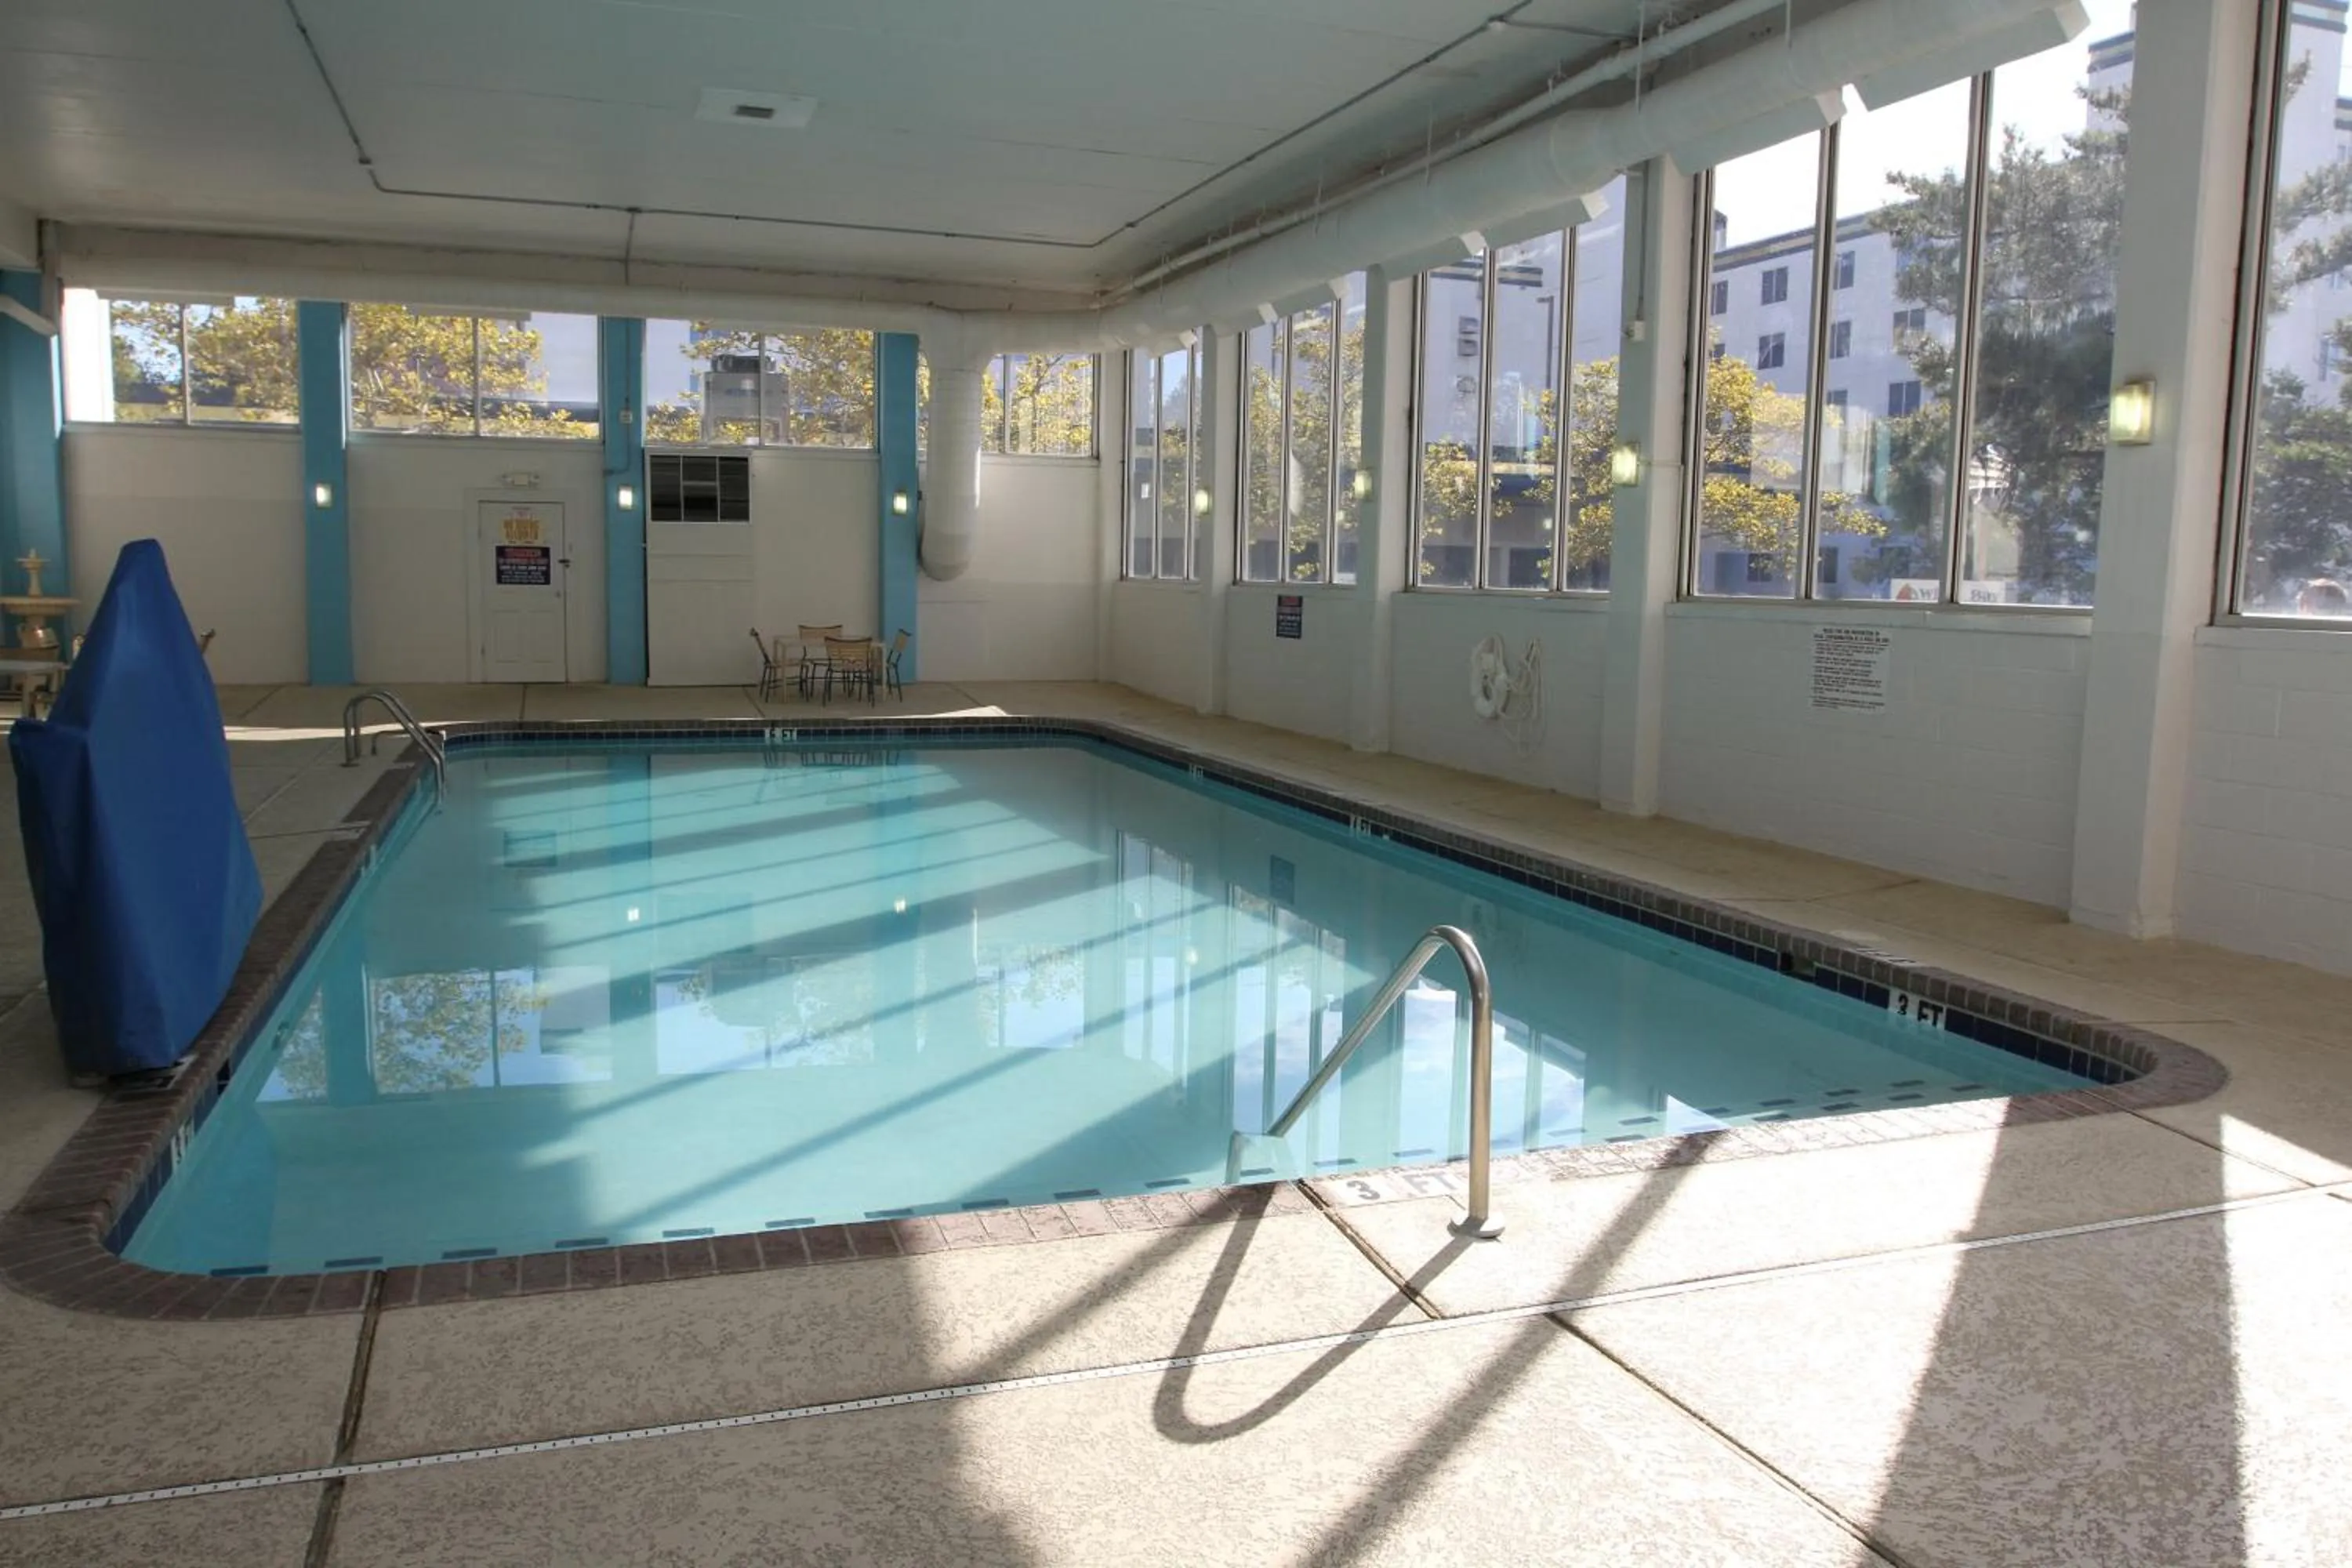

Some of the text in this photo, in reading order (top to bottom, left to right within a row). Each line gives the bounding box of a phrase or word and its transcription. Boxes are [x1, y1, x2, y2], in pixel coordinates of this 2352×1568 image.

[1897, 993, 1944, 1027] 3 FT
[1346, 1171, 1457, 1200] 3 FT
